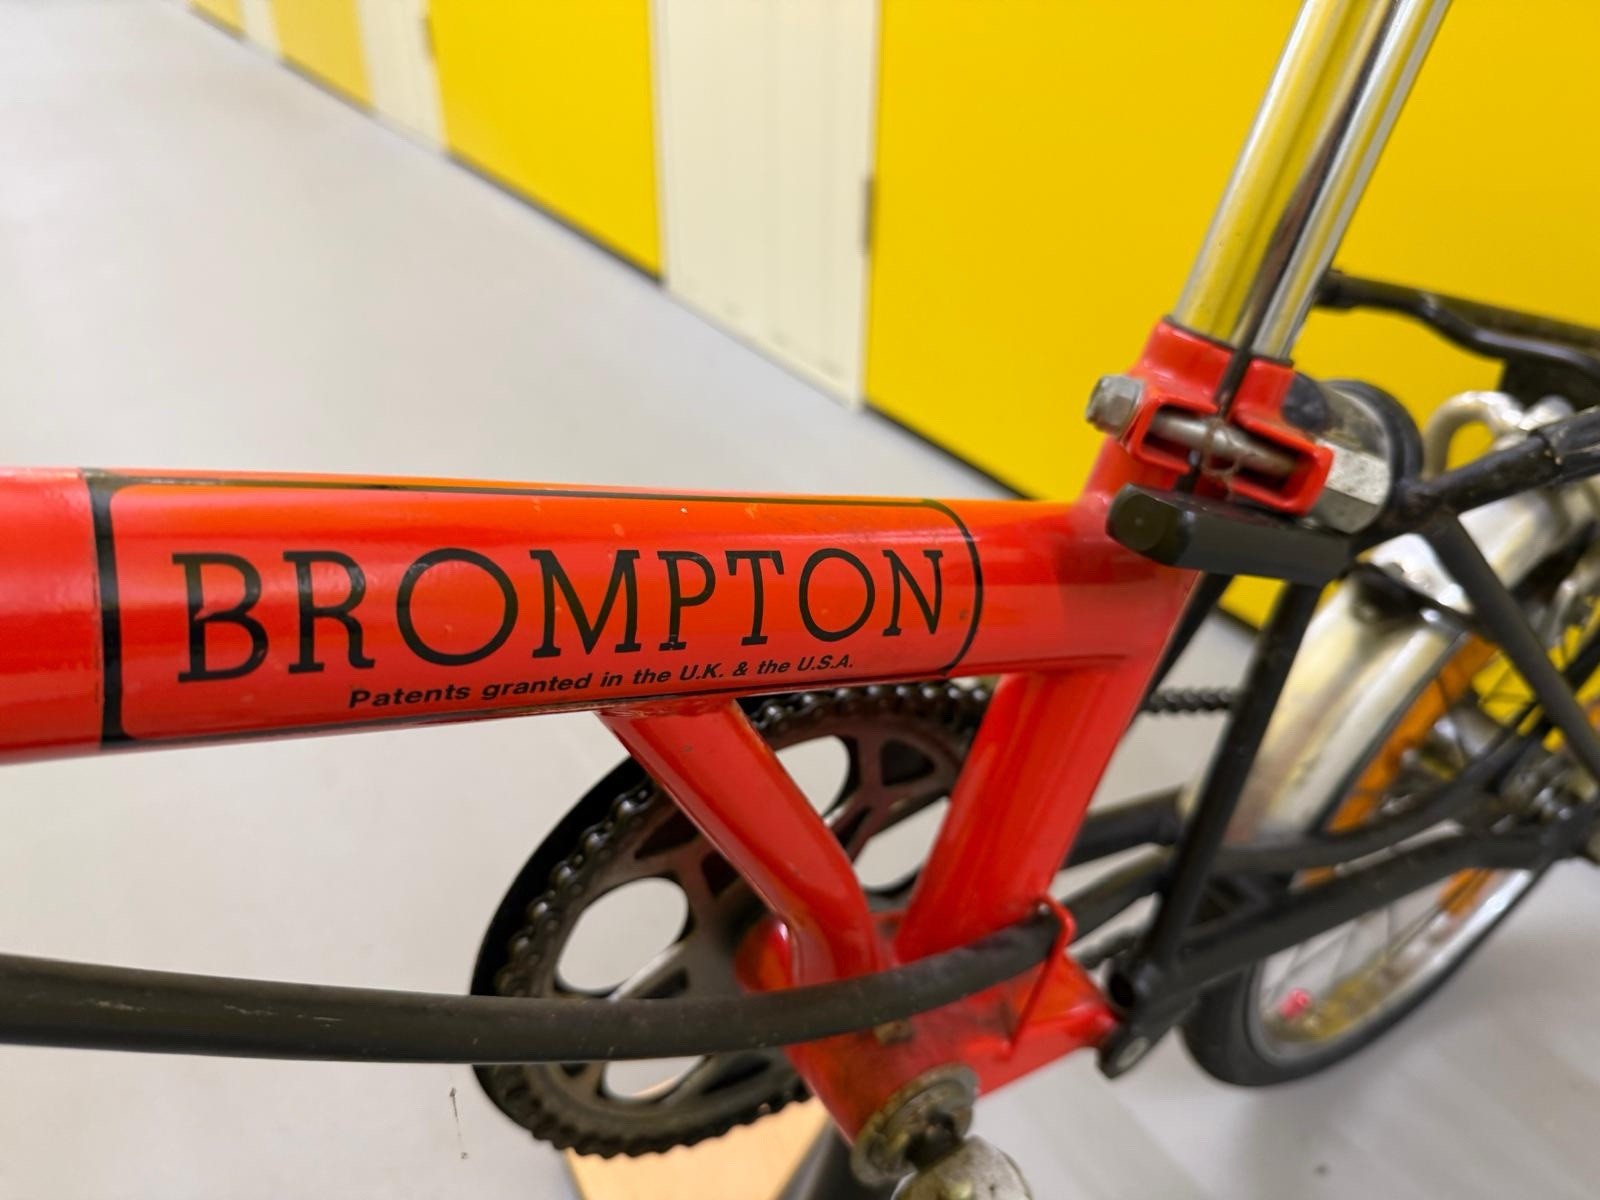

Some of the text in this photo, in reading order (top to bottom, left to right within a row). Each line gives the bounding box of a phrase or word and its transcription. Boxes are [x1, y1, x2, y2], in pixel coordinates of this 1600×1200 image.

[172, 547, 943, 684] BROMPTON
[349, 654, 854, 709] Patents granted in the U.K. & the U.S.A.
